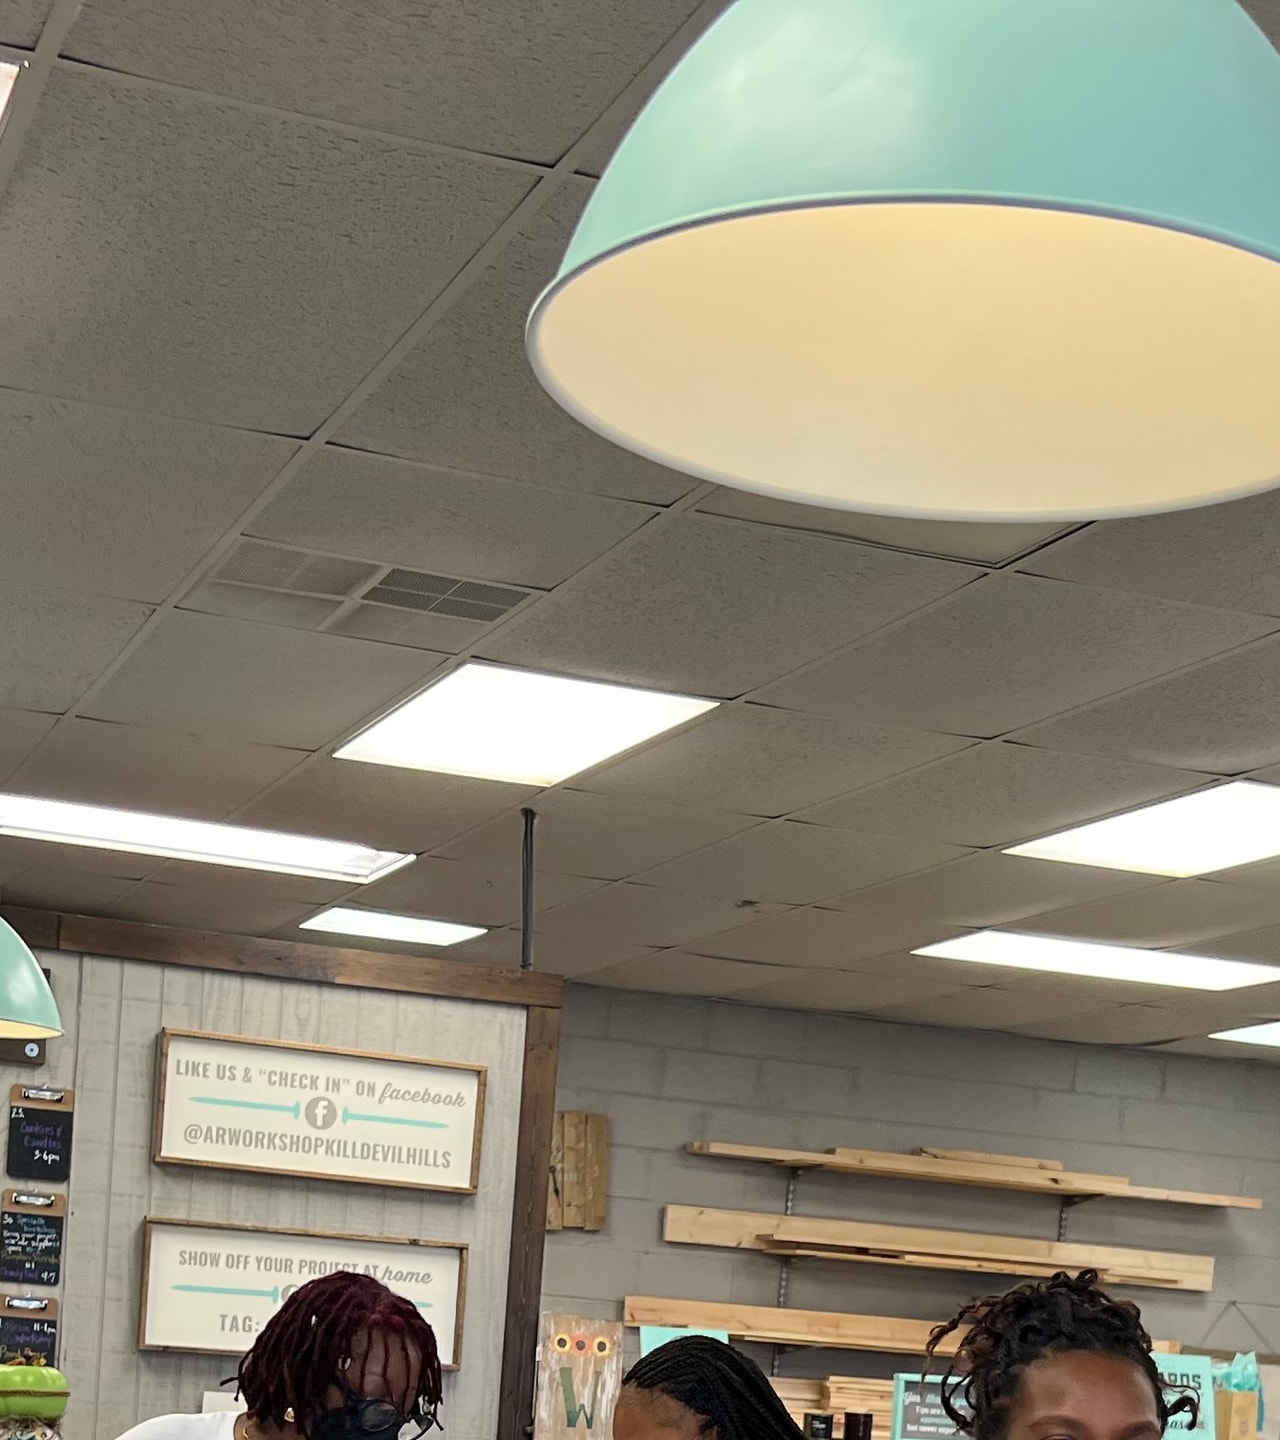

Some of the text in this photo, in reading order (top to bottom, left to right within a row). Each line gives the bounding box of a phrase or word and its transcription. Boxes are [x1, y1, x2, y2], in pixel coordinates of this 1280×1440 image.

[176, 1059, 211, 1079] LIKE
[216, 1064, 237, 1082] US
[242, 1067, 253, 1083] &
[356, 1081, 376, 1097] ON
[378, 1082, 466, 1109] facebook
[184, 1123, 451, 1169] @ARWORKSHOPKILLDEVILHILLS
[179, 1250, 220, 1268] SHOW
[225, 1253, 251, 1271] OFF
[256, 1256, 293, 1274] YOUR
[382, 1265, 433, 1285] home
[219, 1313, 260, 1334] TAG:
